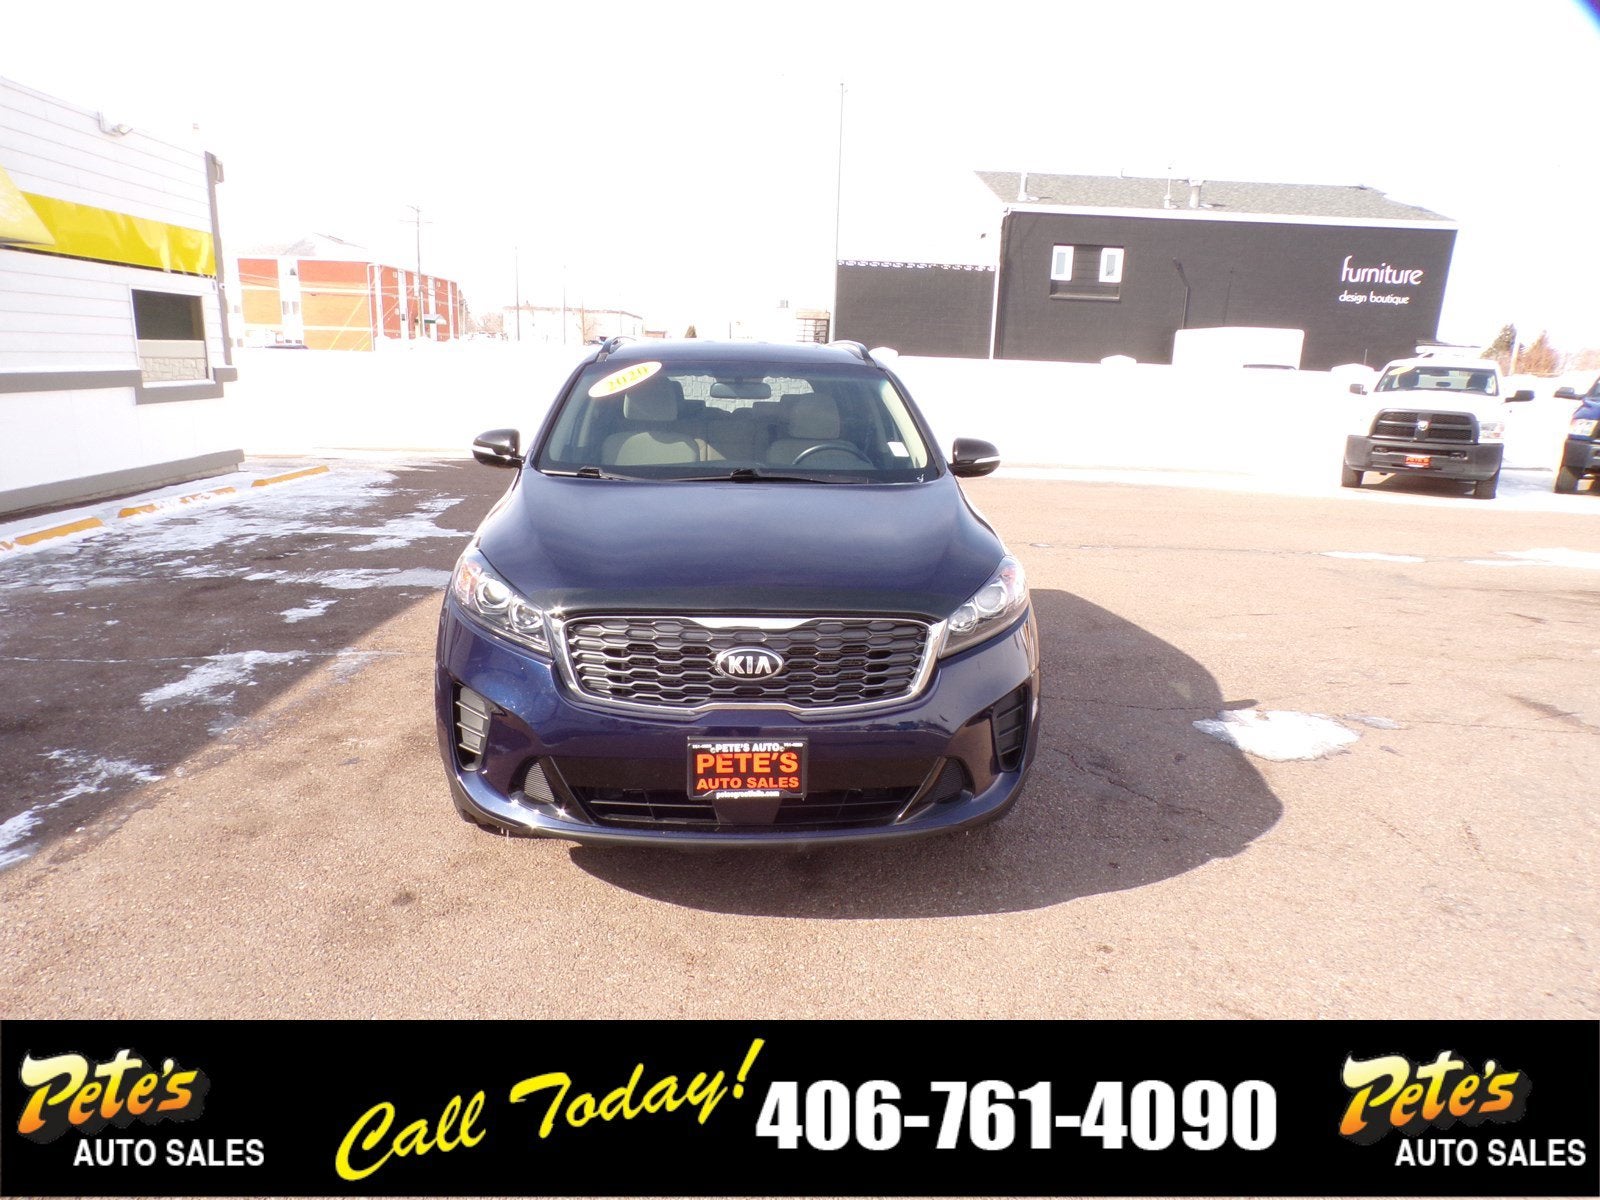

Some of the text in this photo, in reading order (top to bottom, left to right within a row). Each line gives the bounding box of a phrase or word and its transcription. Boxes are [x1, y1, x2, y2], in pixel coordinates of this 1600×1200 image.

[1341, 255, 1424, 285] furniture
[1338, 290, 1410, 305] design boutique
[608, 365, 649, 392] 2020
[728, 655, 772, 675] KIA
[715, 743, 750, 752] PETE'S
[752, 743, 780, 752] AUTO
[696, 752, 798, 774] PETE'S
[696, 777, 799, 790] AUTO SALES
